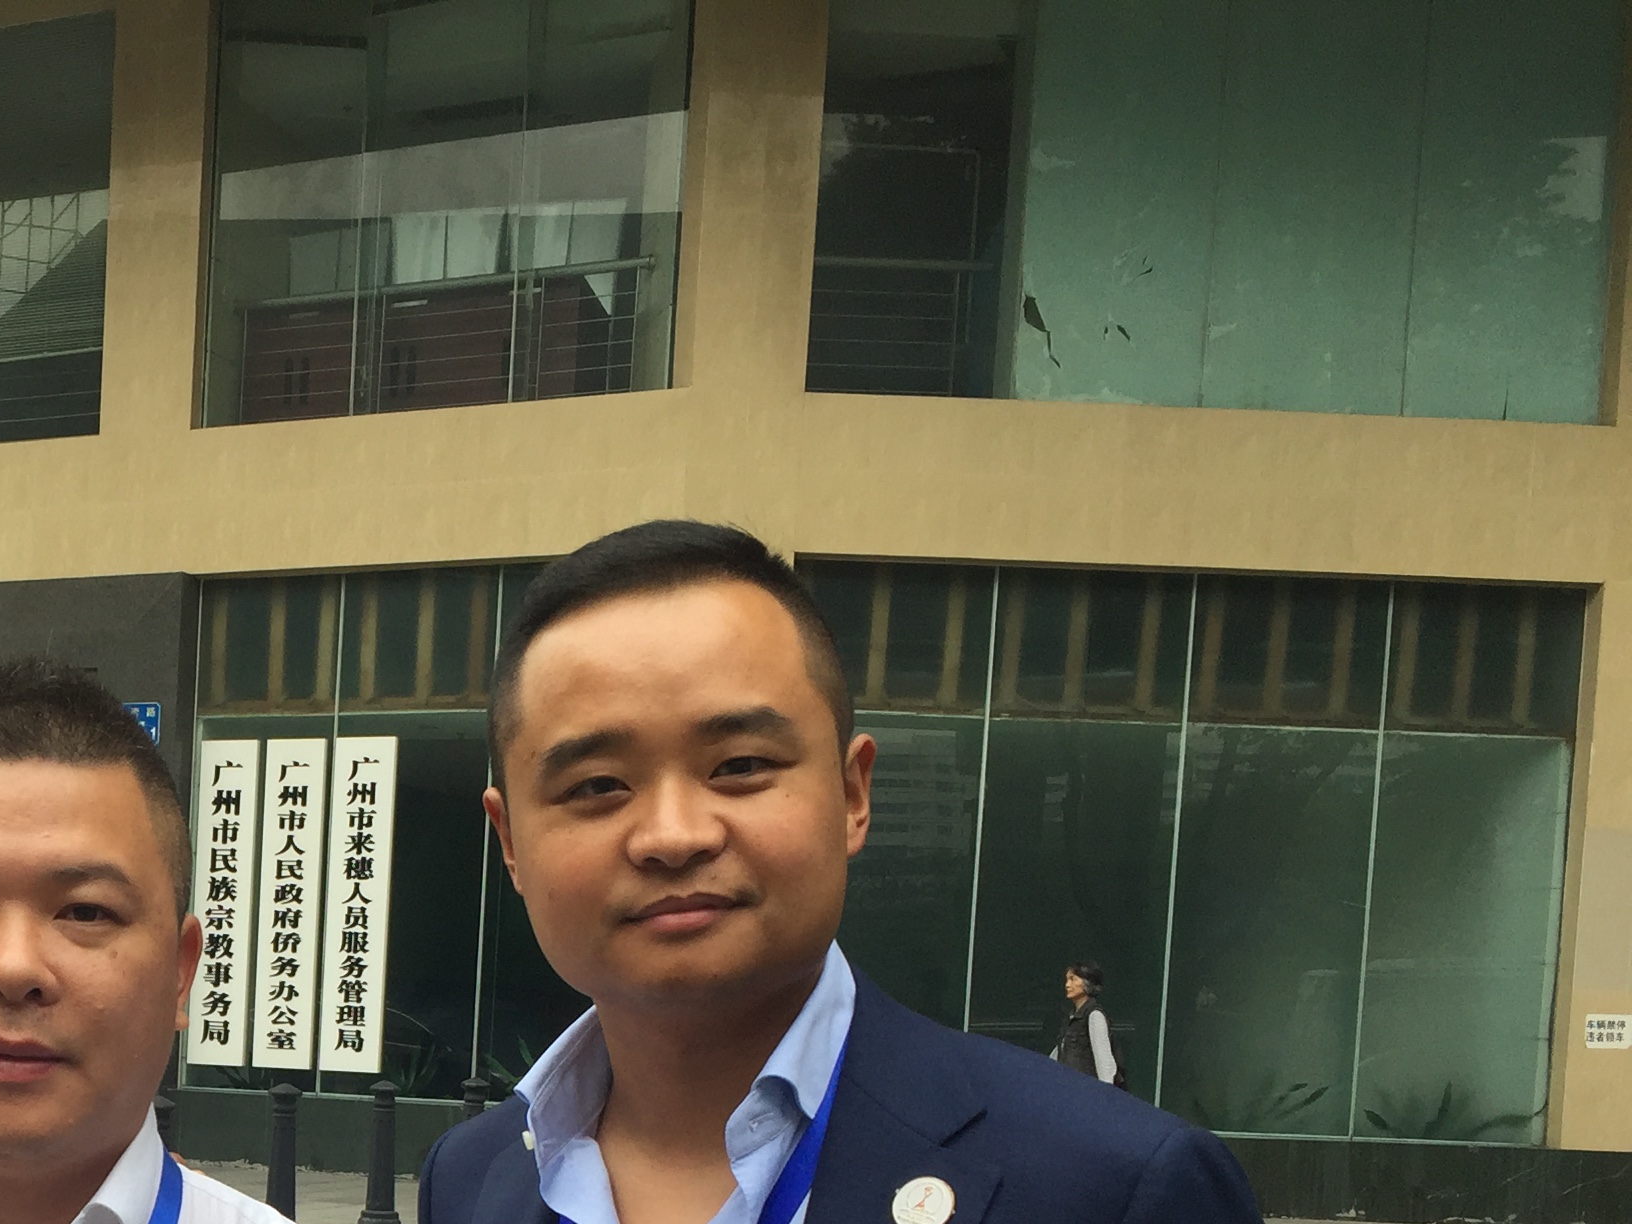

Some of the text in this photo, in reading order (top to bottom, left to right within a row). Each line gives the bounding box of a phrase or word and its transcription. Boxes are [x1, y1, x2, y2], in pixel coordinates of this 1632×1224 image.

[201, 760, 243, 1046] 广州市民族宗教事务局
[266, 761, 310, 1051] 广州市人民政府侨务办公室
[334, 757, 380, 1054] 广州市来穗人员服务管理局
